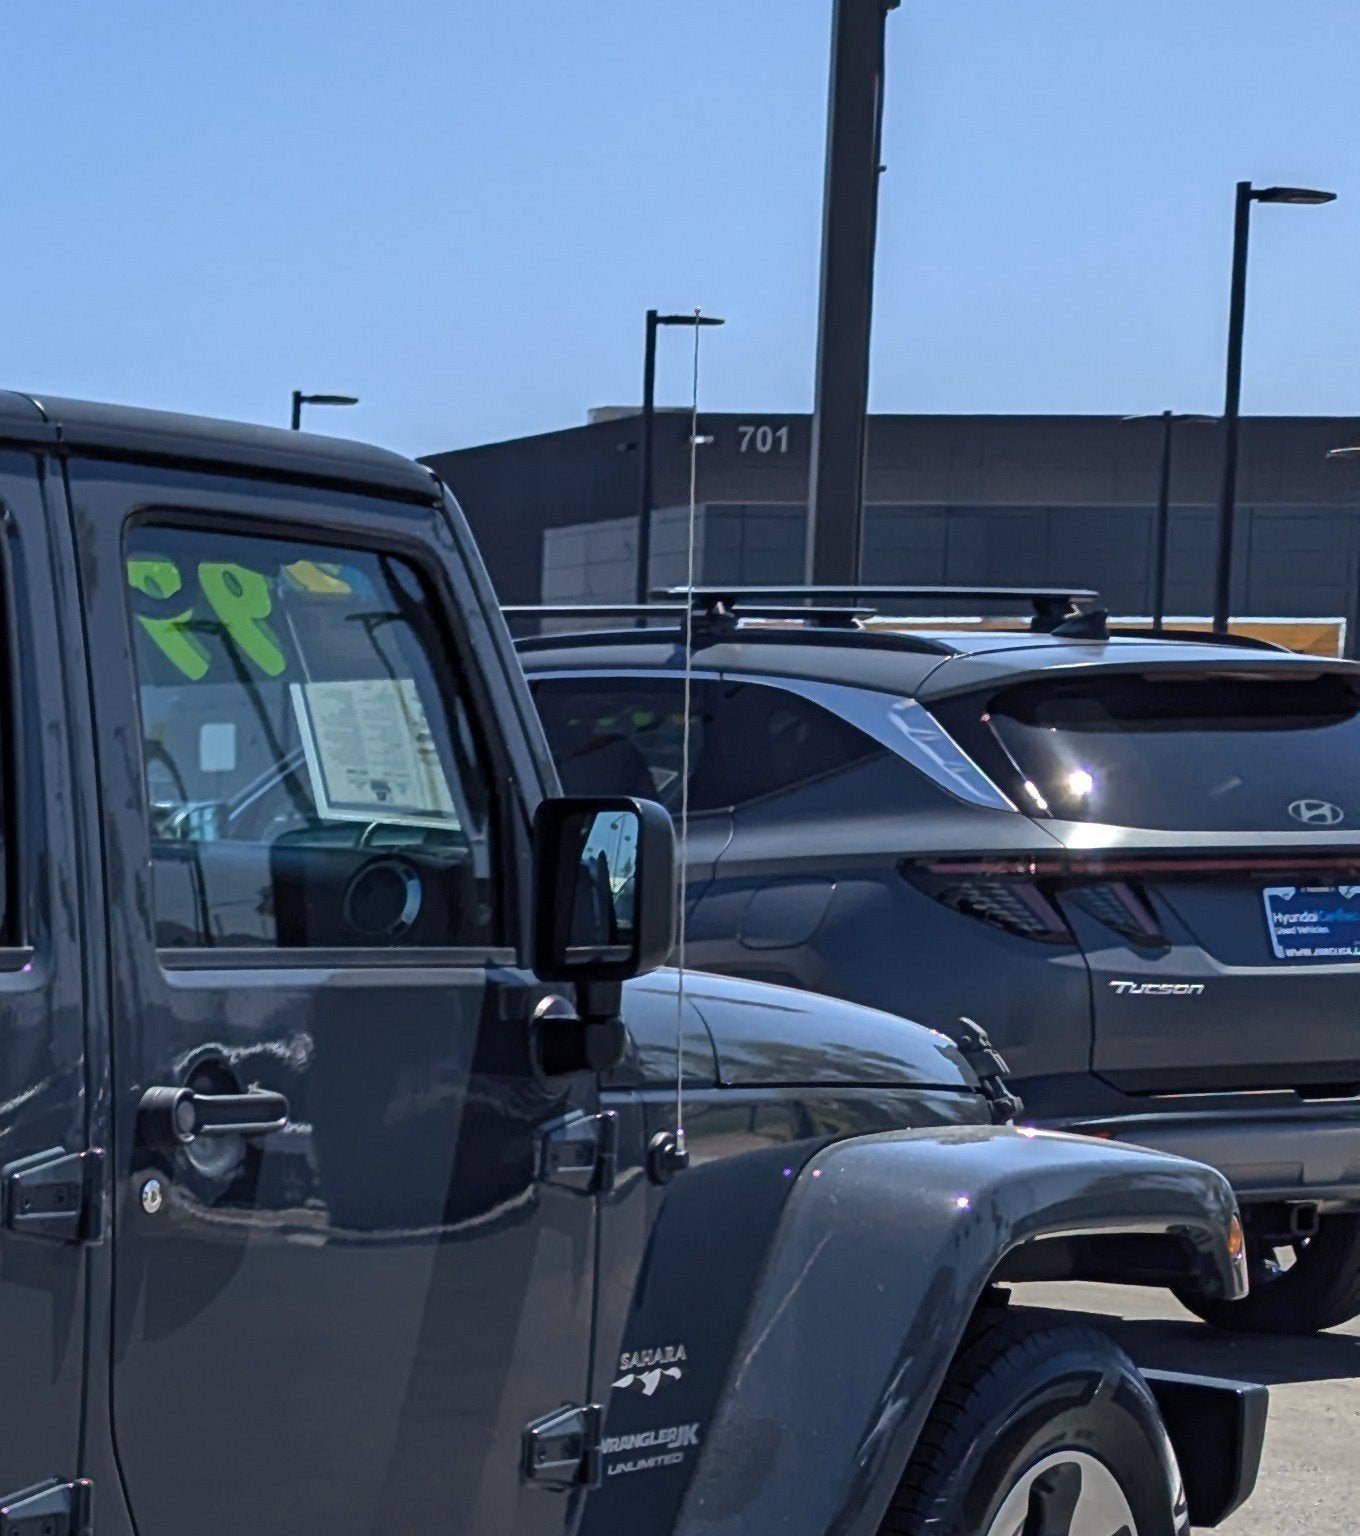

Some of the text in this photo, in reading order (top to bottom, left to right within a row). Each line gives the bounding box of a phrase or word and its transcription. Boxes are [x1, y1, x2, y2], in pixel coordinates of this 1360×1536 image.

[738, 425, 789, 452] 701
[1109, 980, 1205, 995] Tucson
[619, 1344, 687, 1371] SAHARA
[607, 1452, 684, 1476] UNLIMITED
